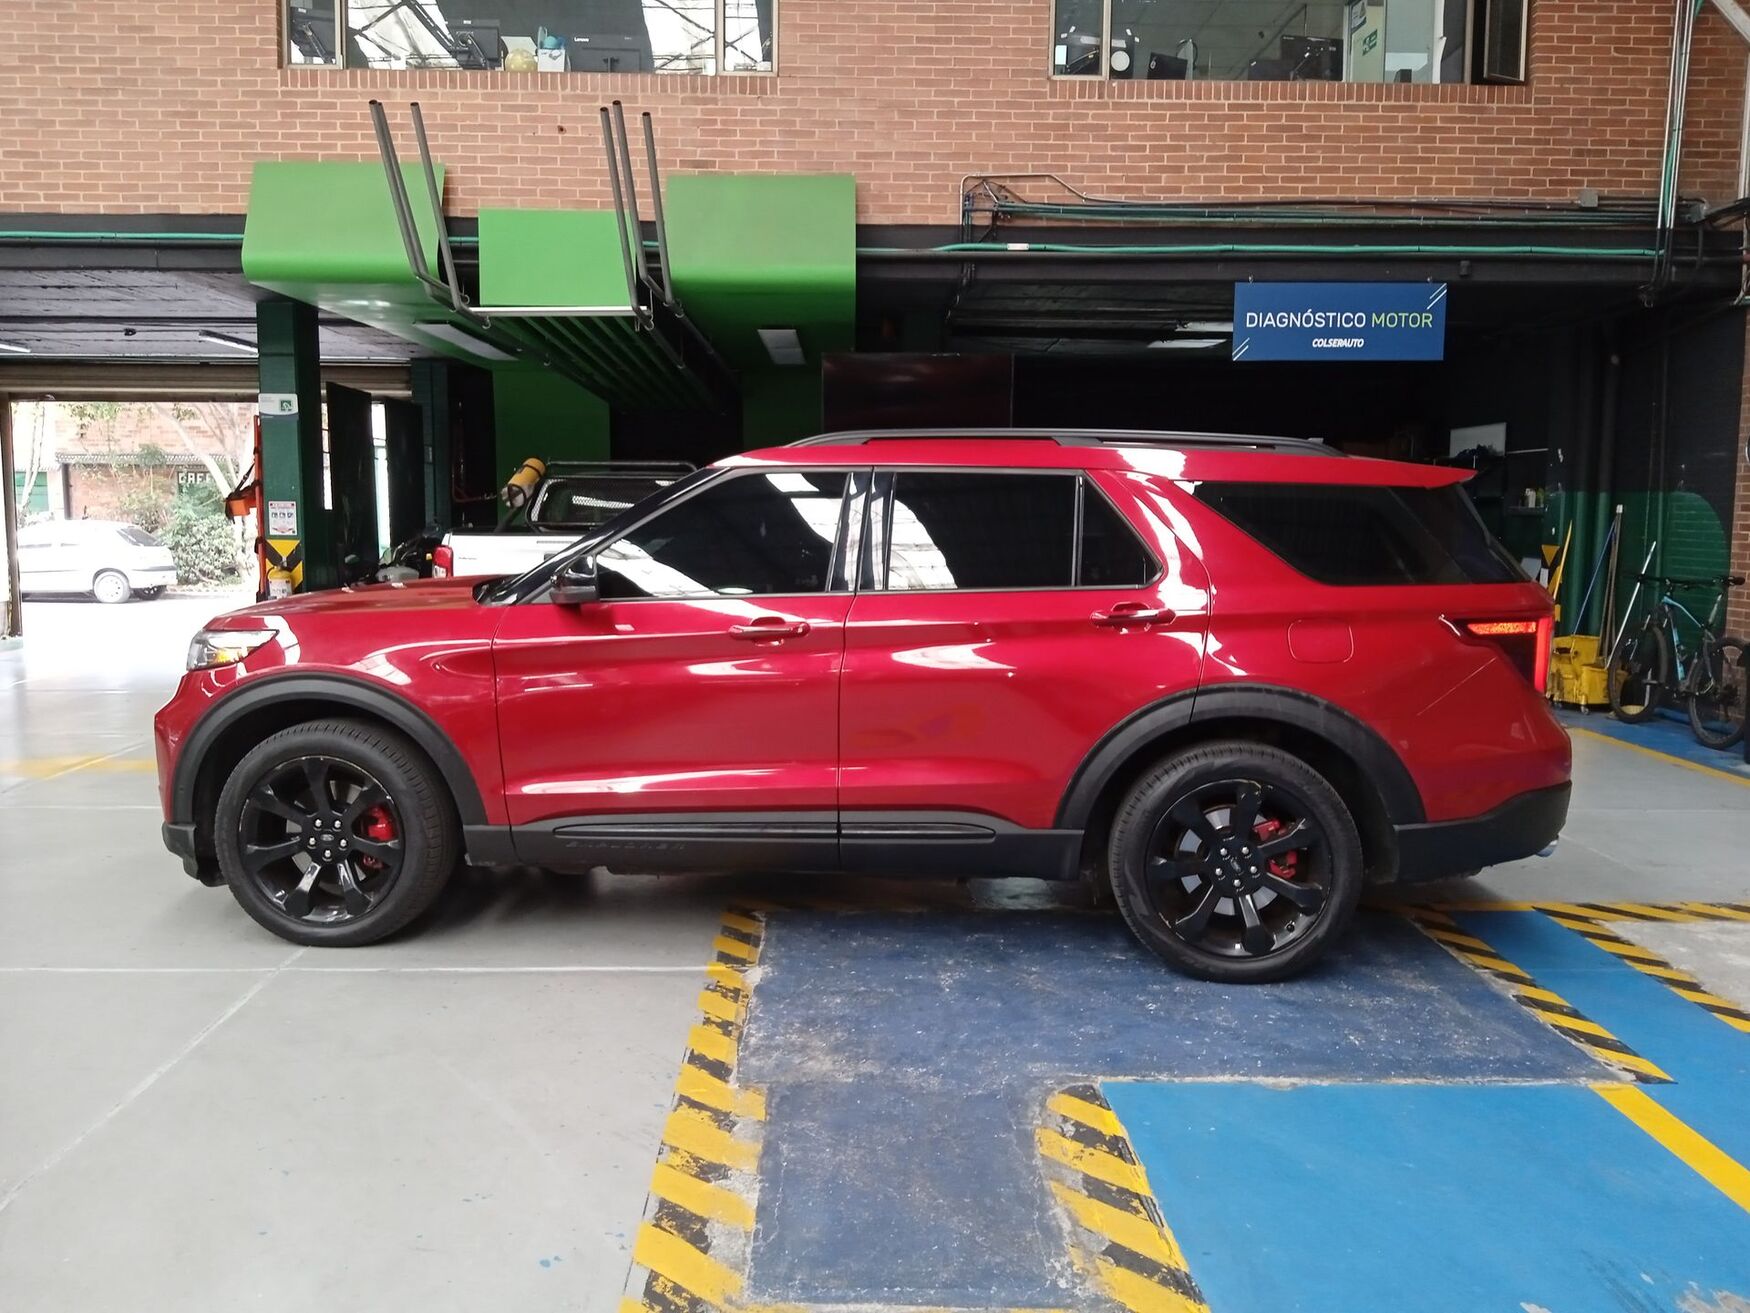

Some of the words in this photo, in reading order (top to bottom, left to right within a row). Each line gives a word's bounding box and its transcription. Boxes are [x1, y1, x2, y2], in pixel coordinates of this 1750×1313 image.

[1246, 309, 1366, 328] DIAGNÓSTICO
[1371, 312, 1433, 328] MOTOR
[1312, 338, 1365, 348] COLSERAUTO
